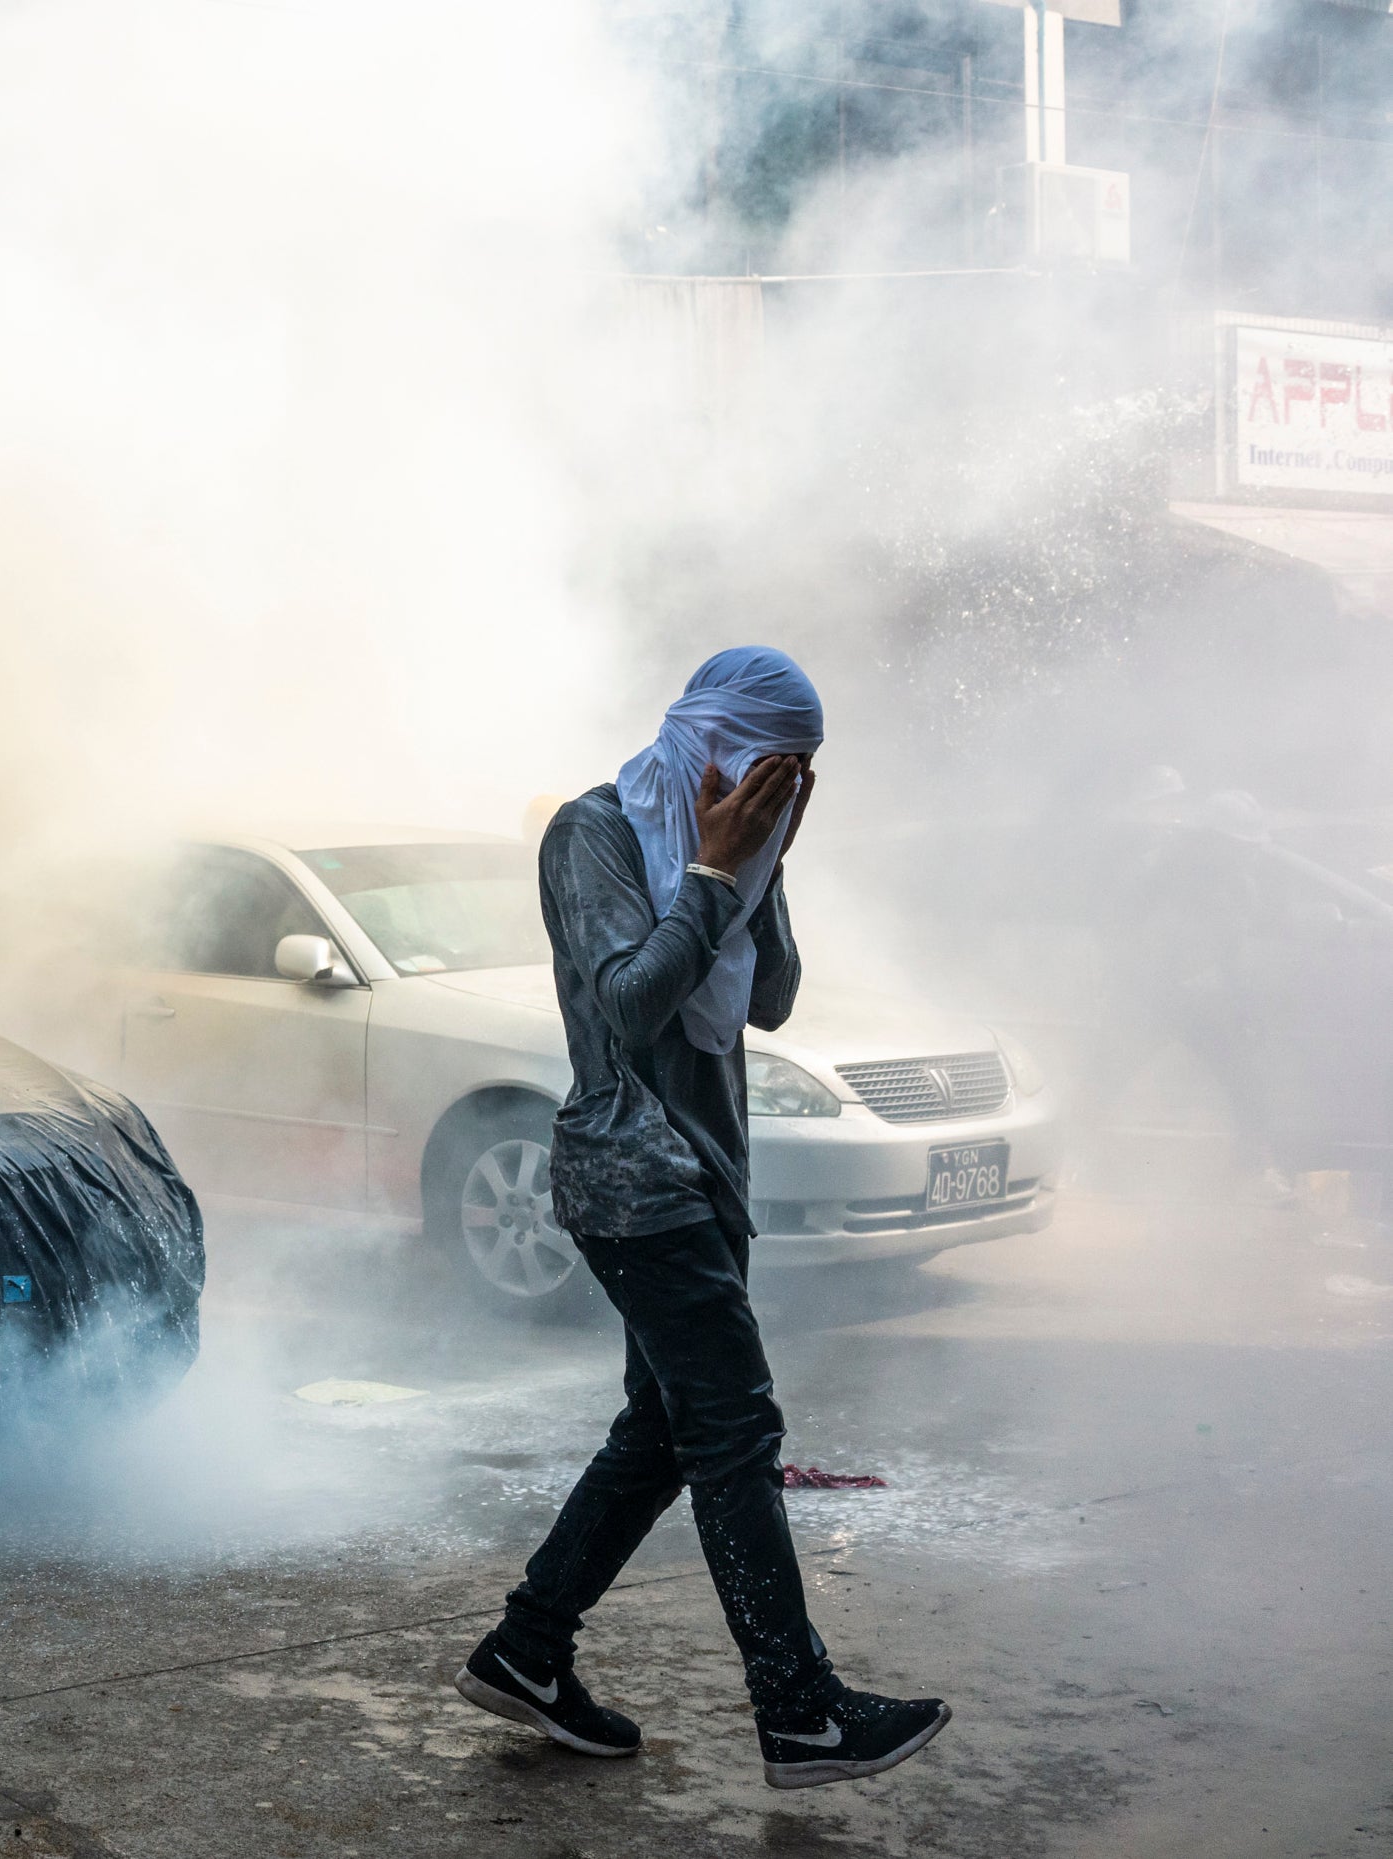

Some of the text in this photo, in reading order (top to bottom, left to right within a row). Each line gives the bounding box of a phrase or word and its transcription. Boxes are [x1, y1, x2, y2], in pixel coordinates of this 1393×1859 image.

[1248, 356, 1393, 432] APPL
[954, 1149, 979, 1167] YGN
[931, 1165, 1000, 1204] 4D-9768
